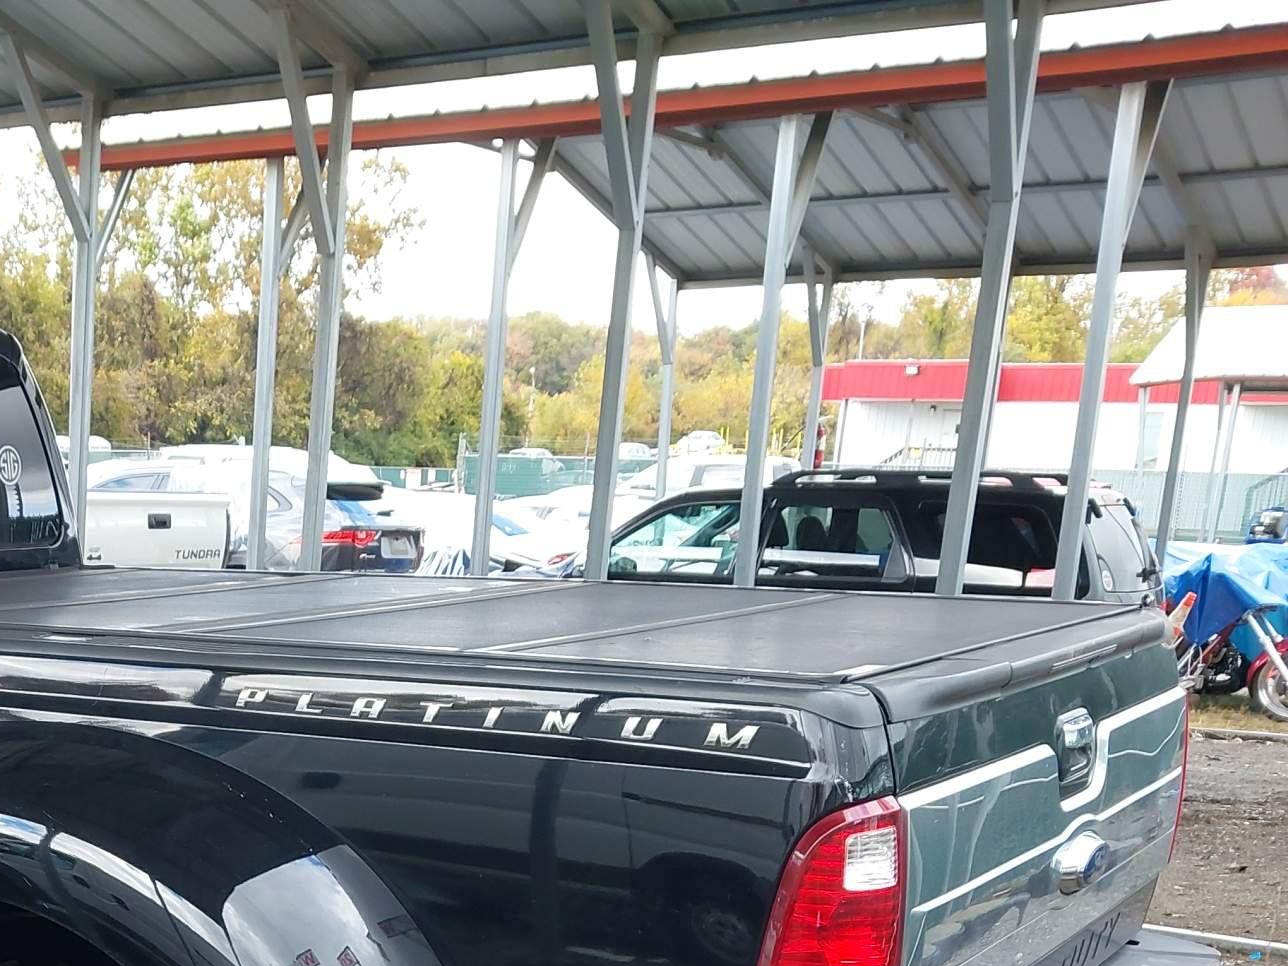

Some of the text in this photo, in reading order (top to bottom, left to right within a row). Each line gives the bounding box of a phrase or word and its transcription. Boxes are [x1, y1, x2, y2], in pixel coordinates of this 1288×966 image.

[0, 450, 19, 481] SIG
[175, 549, 221, 560] TUNDRA
[233, 687, 760, 749] PLATINUM
